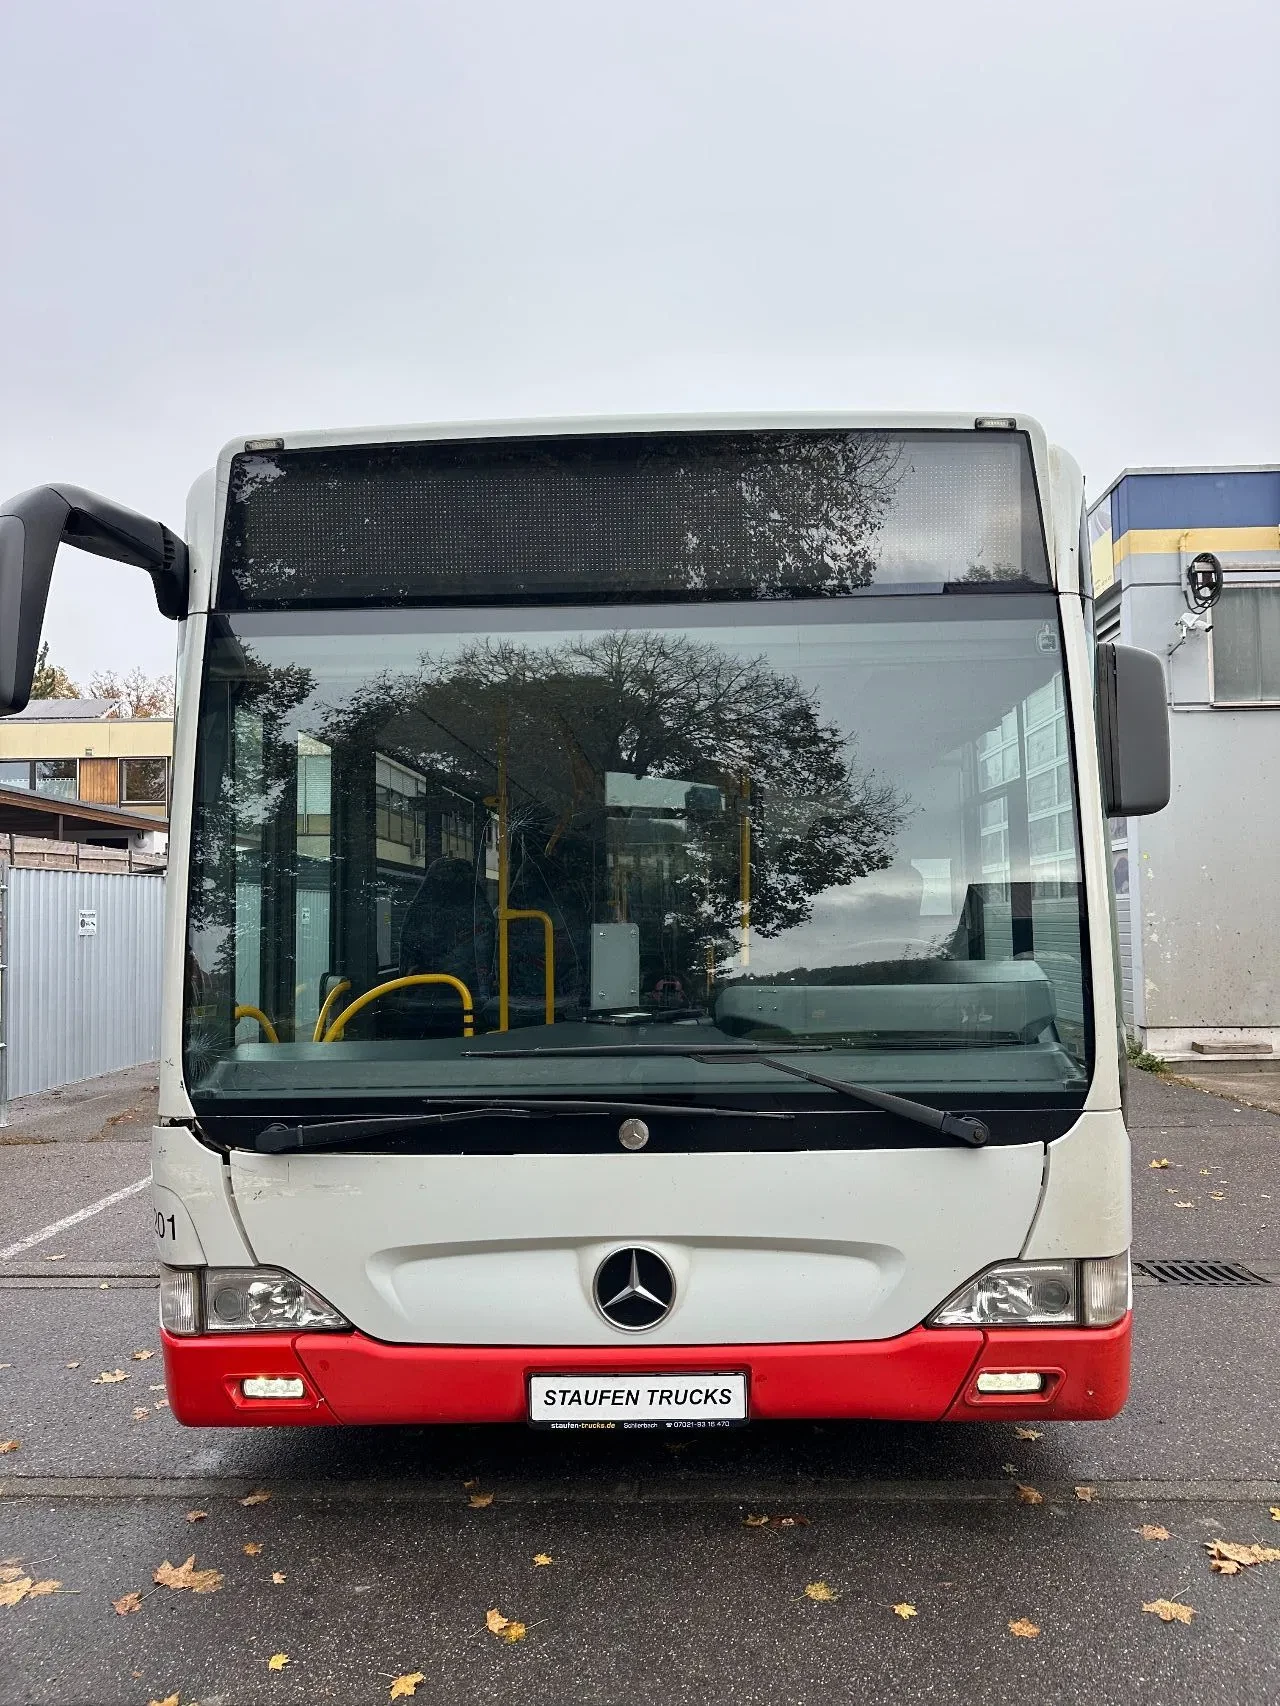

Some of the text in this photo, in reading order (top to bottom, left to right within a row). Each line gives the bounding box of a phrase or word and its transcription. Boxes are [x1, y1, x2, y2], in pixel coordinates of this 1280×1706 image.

[154, 1207, 176, 1240] 01
[543, 1388, 732, 1406] STAUFEN TRUCKS
[551, 1421, 616, 1429] staufen-trucks.de
